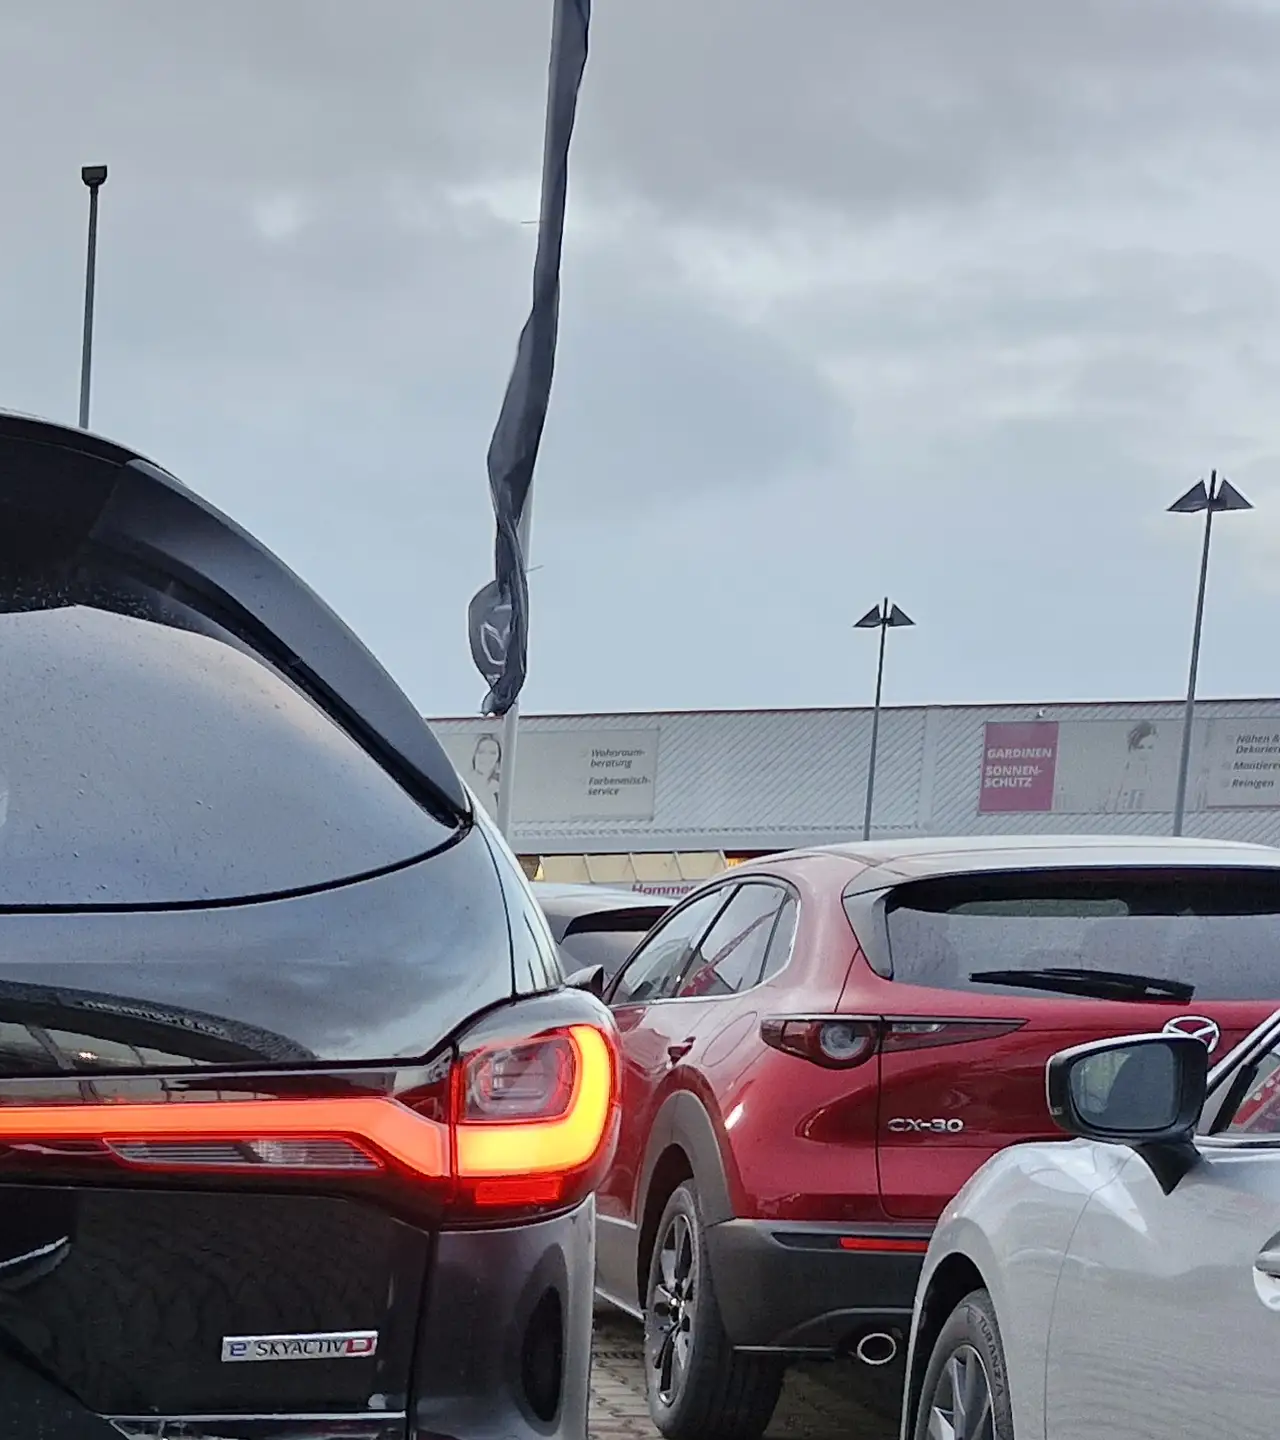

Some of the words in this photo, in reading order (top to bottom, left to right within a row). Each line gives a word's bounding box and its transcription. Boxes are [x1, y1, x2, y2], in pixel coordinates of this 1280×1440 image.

[987, 747, 1052, 760] GARDINEN
[1235, 745, 1280, 754] Dekorier
[590, 759, 633, 769] beratung
[985, 765, 1044, 777] SONNEN-
[984, 777, 1033, 788] SCHUTZ
[1231, 779, 1274, 789] Reinigen
[587, 788, 620, 797] service
[887, 1117, 964, 1133] CX-30
